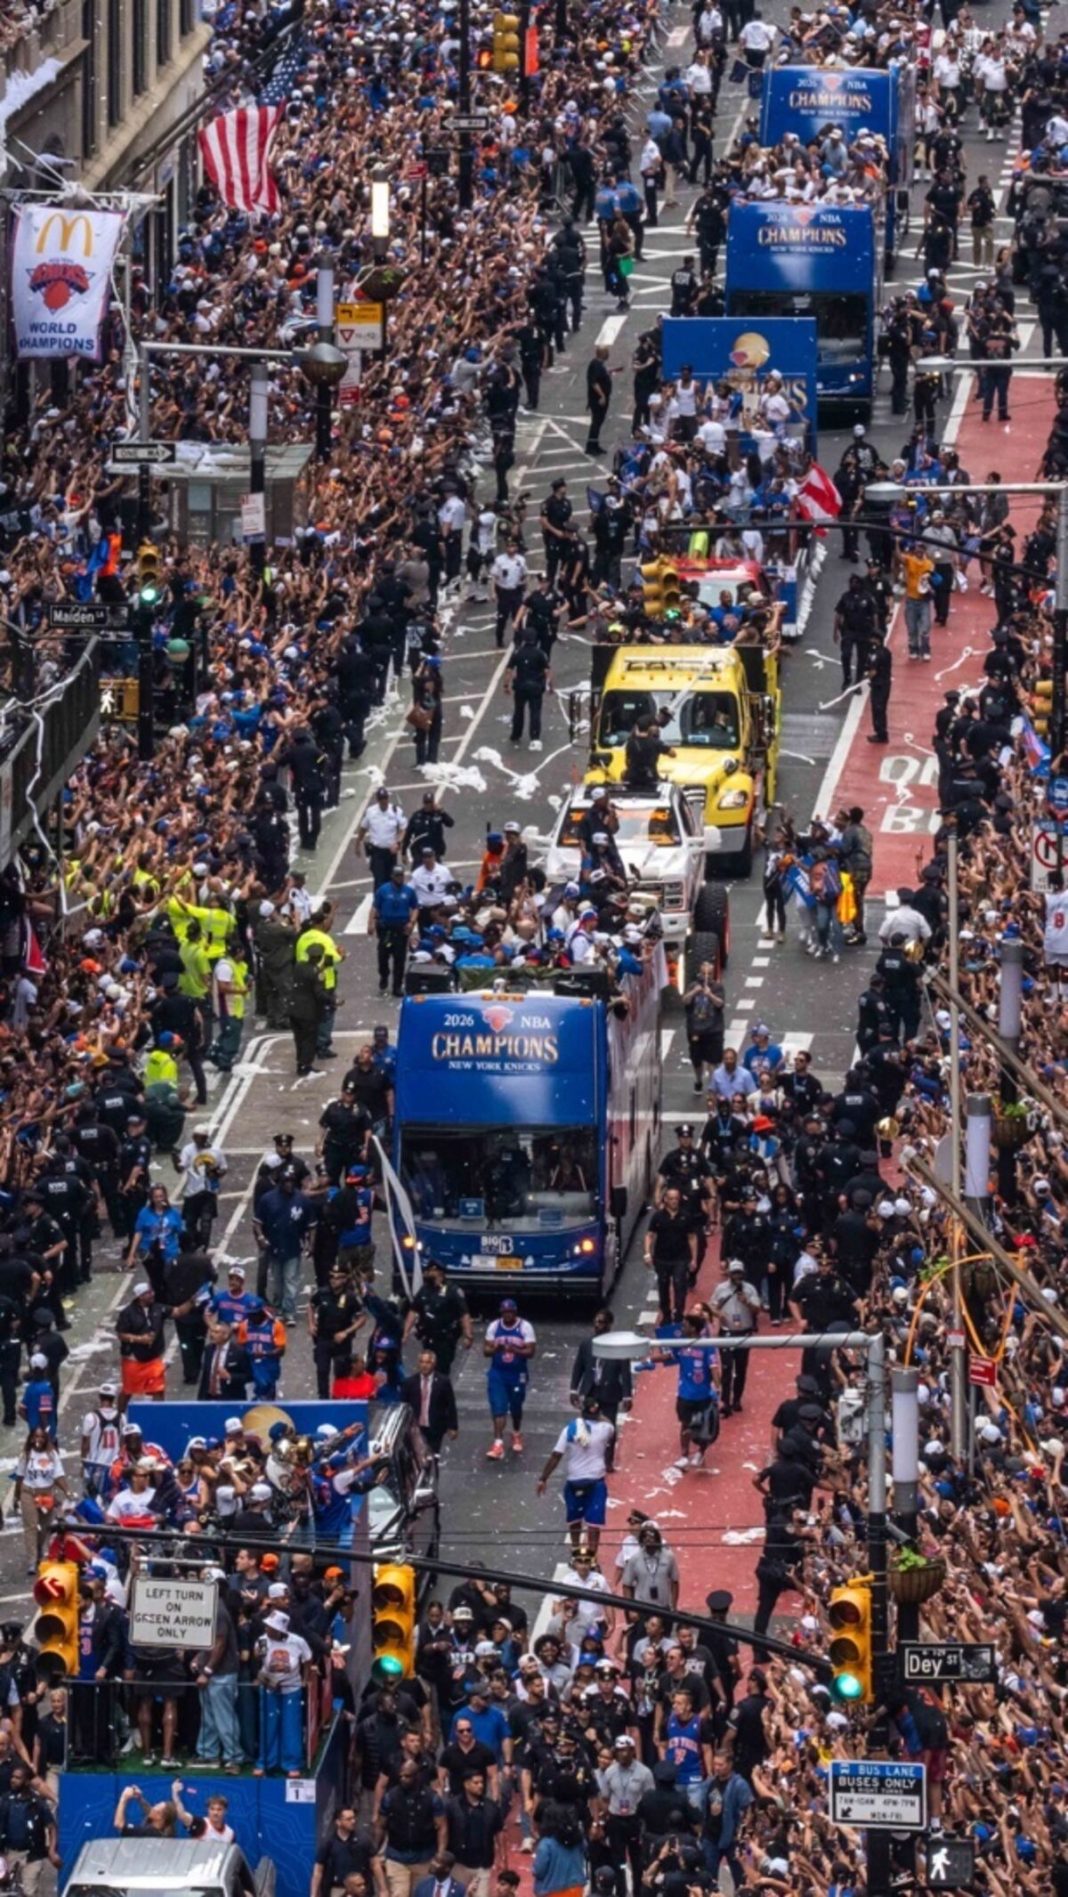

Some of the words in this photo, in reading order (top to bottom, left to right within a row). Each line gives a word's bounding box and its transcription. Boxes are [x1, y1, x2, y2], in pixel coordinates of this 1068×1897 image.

[847, 81, 868, 90] NBA
[789, 91, 872, 113] CHAMPIONS
[820, 214, 842, 224] NBA
[757, 226, 847, 247] CHAMPIONS
[29, 322, 77, 334] WORLD
[121, 450, 138, 459] ONE
[147, 449, 166, 458] WAY
[53, 608, 95, 624] Maiden
[443, 1013, 475, 1027] 2026
[520, 1015, 551, 1029] NBA
[431, 1033, 559, 1062] CHAMPIONS
[448, 1061, 472, 1070] NEW
[475, 1061, 502, 1070] YORK
[503, 1062, 541, 1071] KNICKS
[481, 1236, 500, 1246] BIG
[102, 1430, 115, 1449] 11
[145, 1588, 171, 1599] LEFT
[175, 1590, 204, 1601] TURN
[166, 1602, 182, 1612] ON
[173, 1615, 212, 1627] ARROW
[157, 1627, 187, 1639] ONLY
[909, 1655, 942, 1678] Dey
[946, 1655, 958, 1665] ST
[858, 1765, 880, 1775] BUS
[886, 1766, 915, 1777] LANE
[839, 1777, 880, 1787] BUSES
[885, 1779, 916, 1788] ONLY
